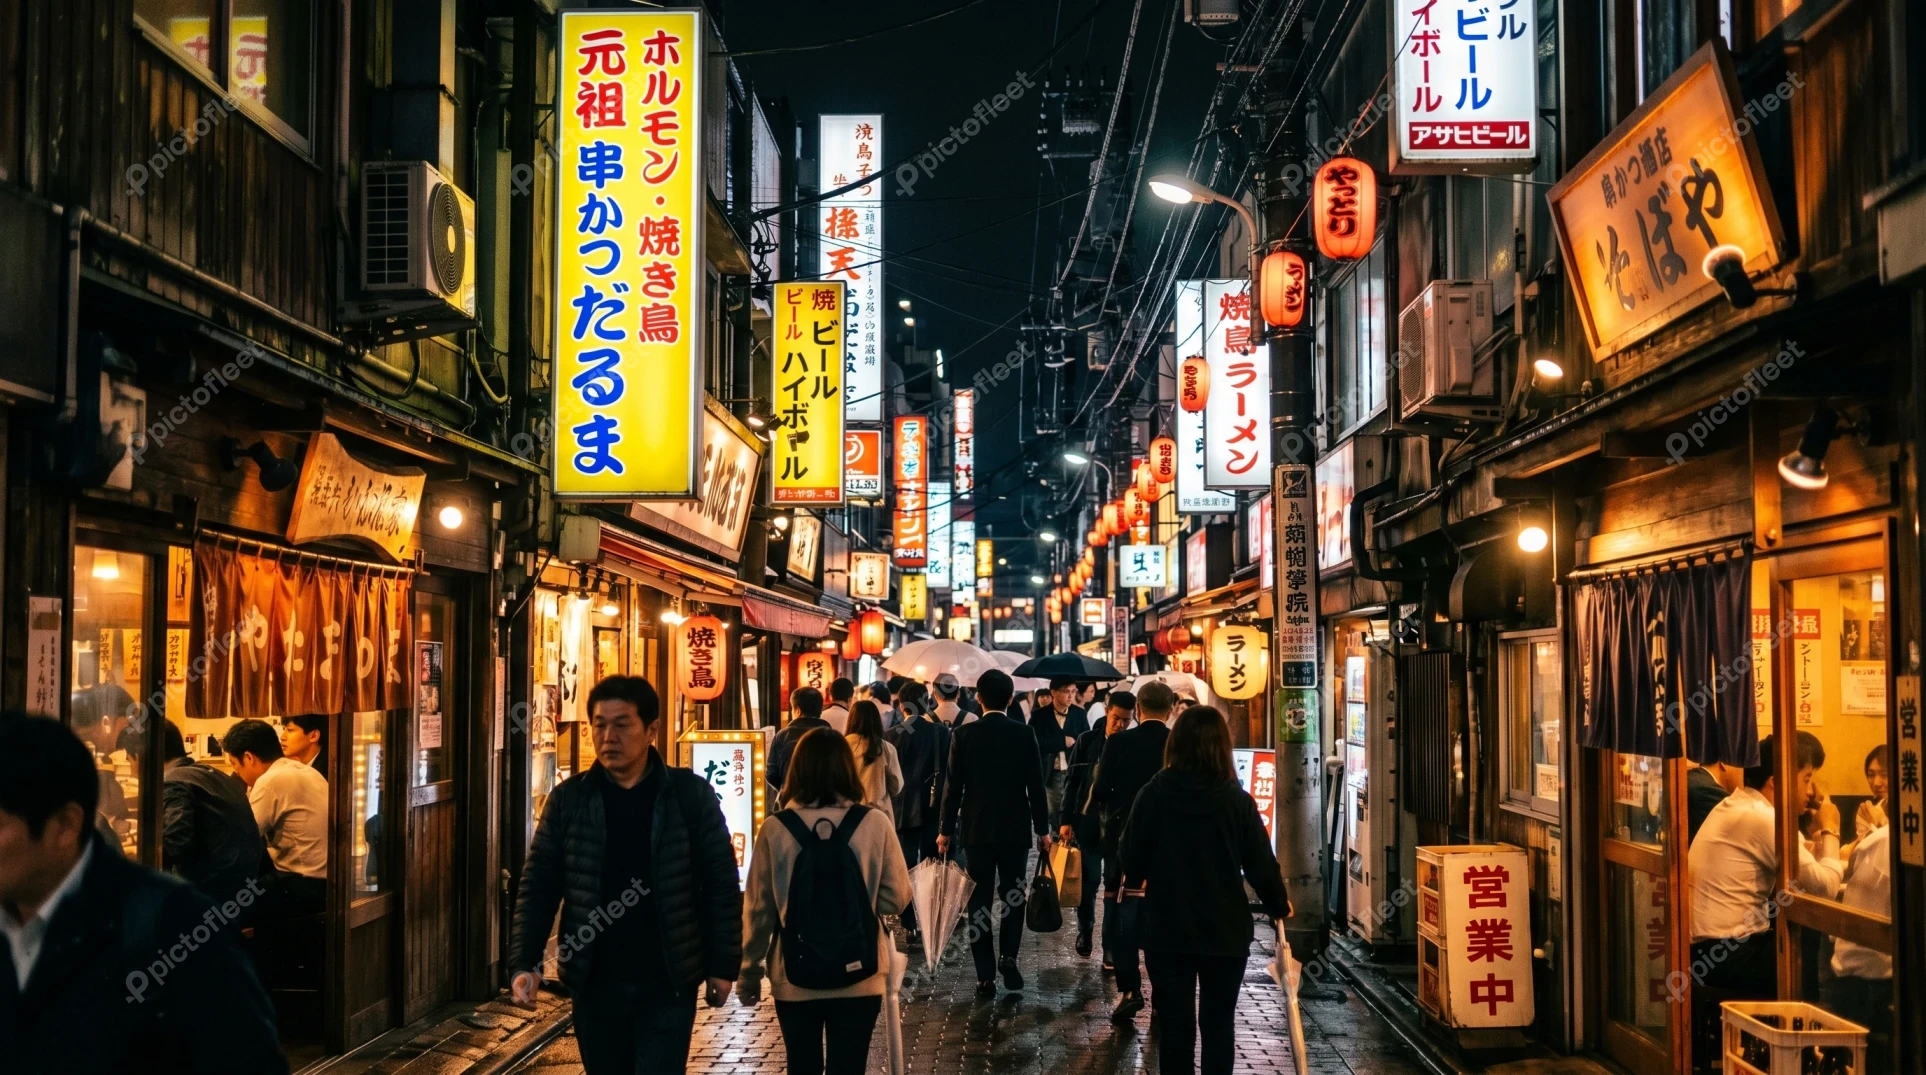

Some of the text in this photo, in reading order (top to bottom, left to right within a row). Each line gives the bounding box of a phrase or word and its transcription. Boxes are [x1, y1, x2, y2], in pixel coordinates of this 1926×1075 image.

[1455, 0, 1492, 110] ビール
[1411, 125, 1528, 145] アサヒビール
[1324, 164, 1360, 238] やっとり
[687, 626, 717, 689] 焼き鳥
[1226, 634, 1247, 693] ラーメン
[1900, 698, 1920, 846] 営業中
[1463, 864, 1514, 1017] 営業中
